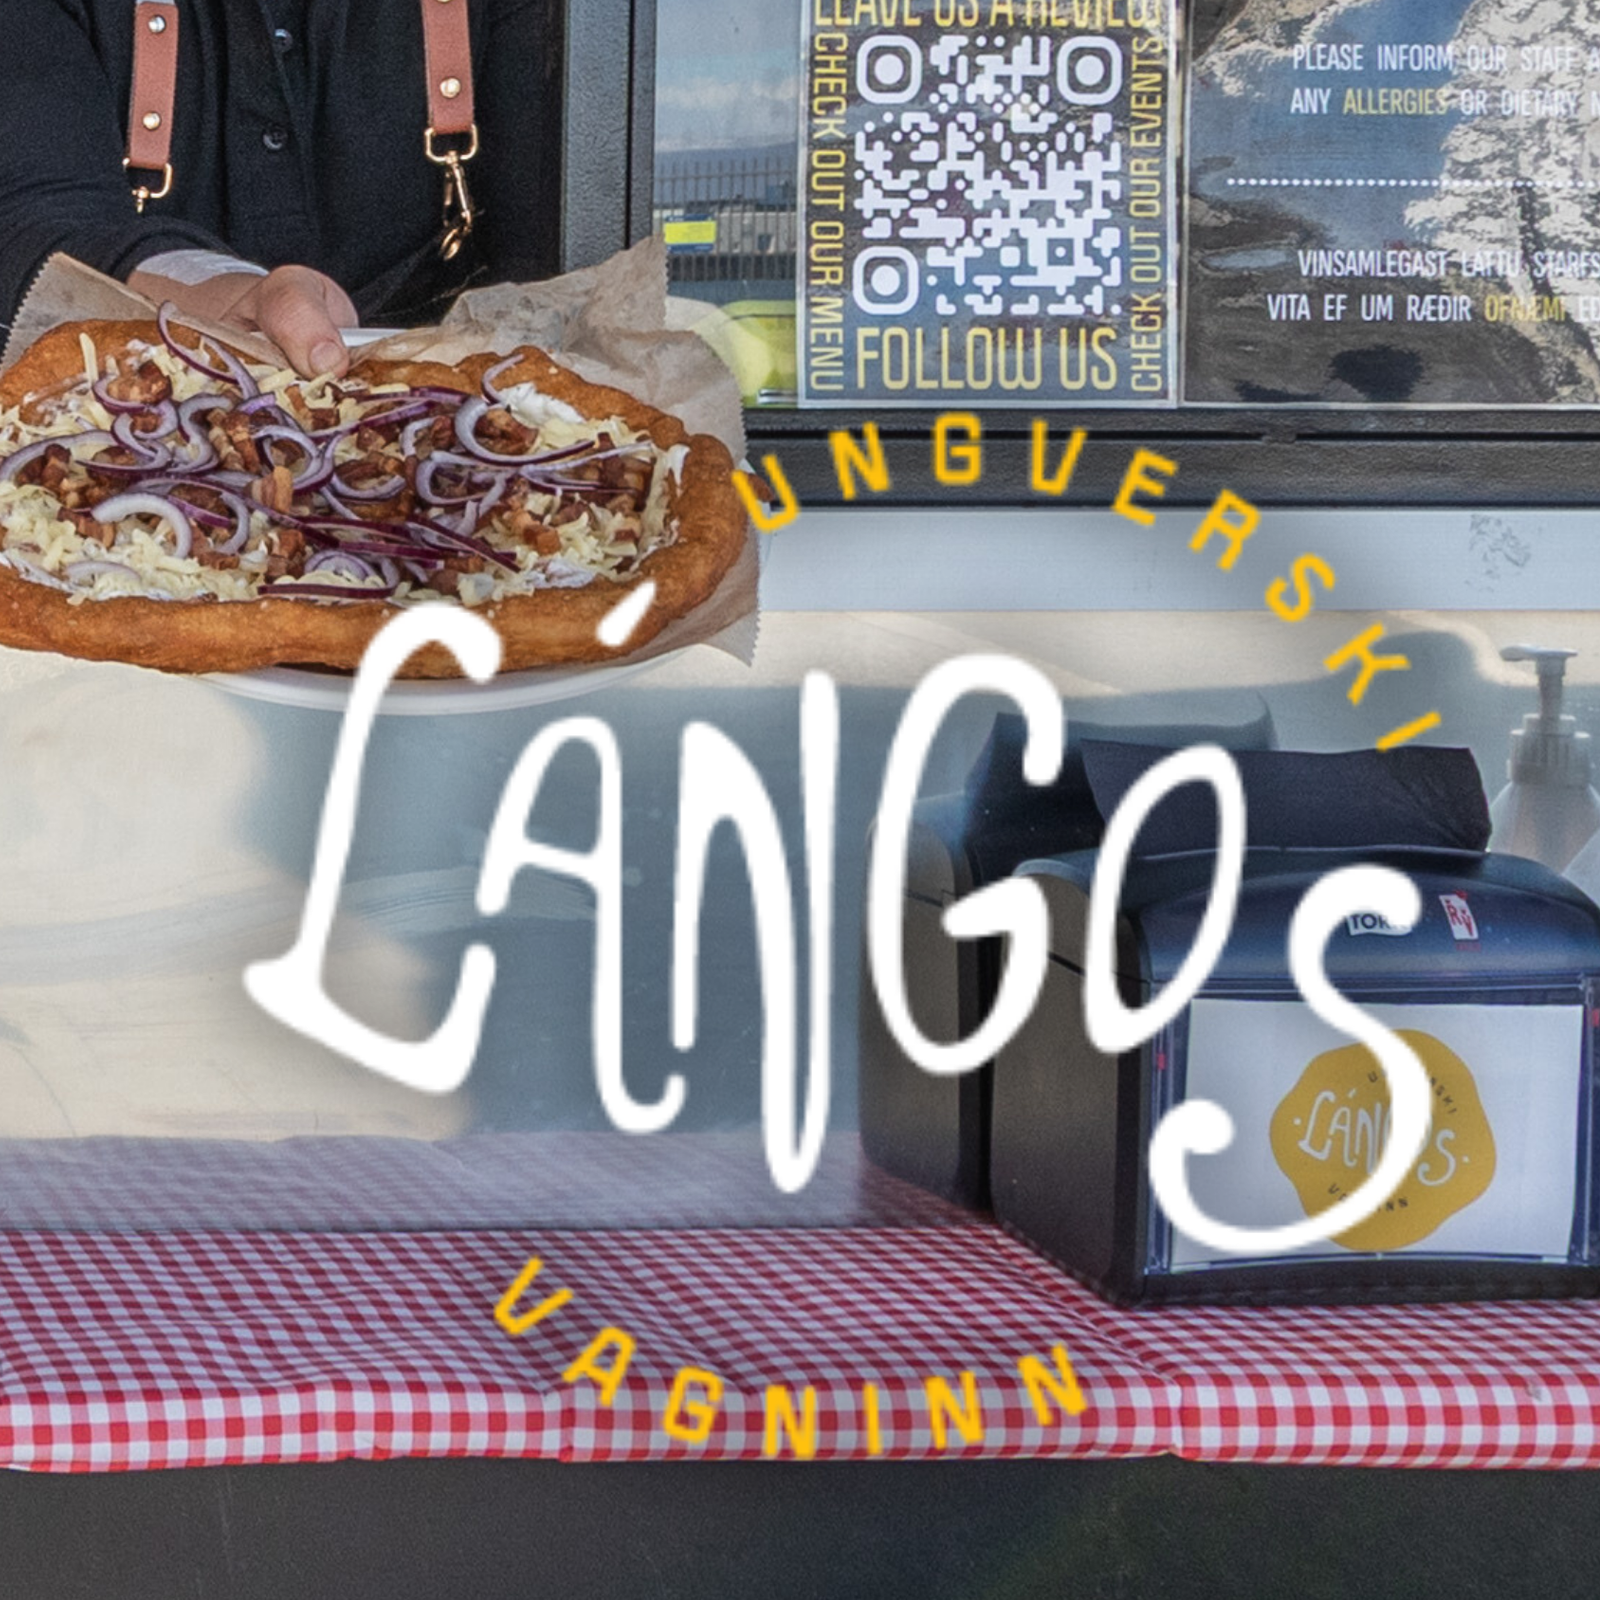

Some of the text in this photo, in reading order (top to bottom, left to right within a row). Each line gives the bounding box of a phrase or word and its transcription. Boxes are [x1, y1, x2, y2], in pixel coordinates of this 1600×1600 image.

[1293, 44, 1364, 71] PLEASE
[1377, 44, 1454, 71] INFORM
[1466, 44, 1507, 72] OUR
[1290, 88, 1331, 114] ANY
[1343, 88, 1449, 115] ALLERGIES
[1460, 88, 1488, 116] OR
[810, 32, 849, 391] CHECK OUT OUR MENU
[1130, 36, 1164, 392] CHECK OUT OUR EVENTS
[1298, 249, 1448, 277] VINSAMLEGAST
[1266, 294, 1311, 321] VITA
[1323, 294, 1348, 321] EF
[1361, 294, 1394, 321] UM
[856, 326, 1118, 391] FOLLOW US
